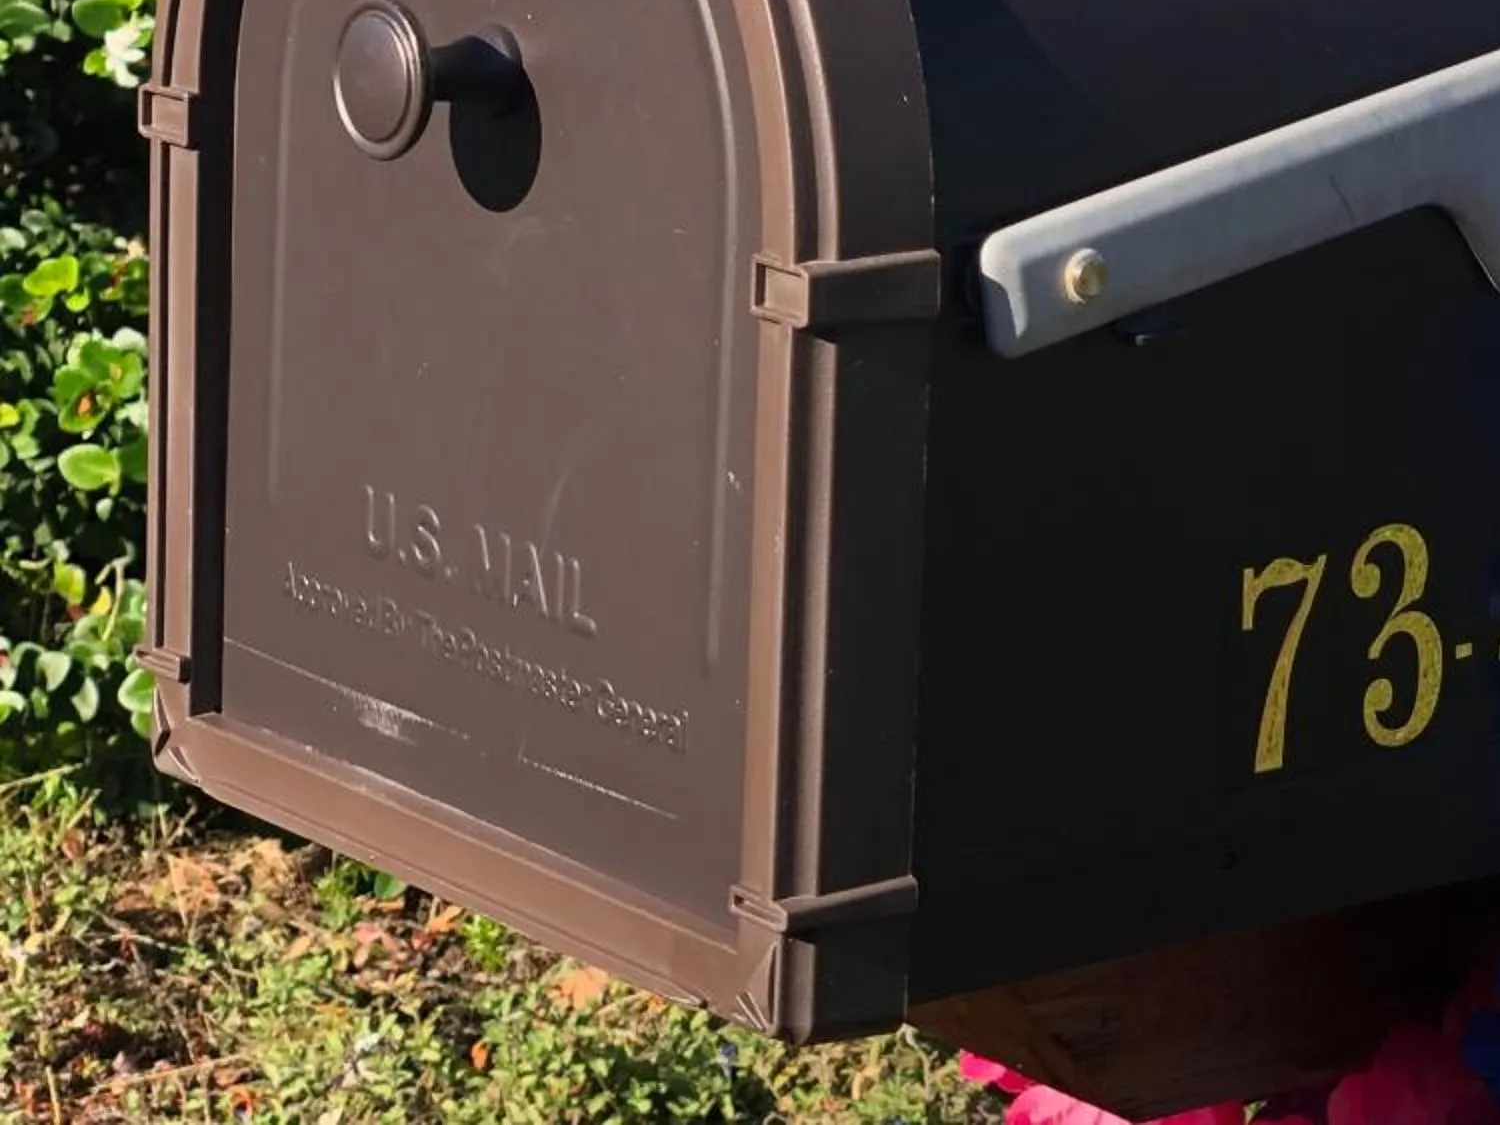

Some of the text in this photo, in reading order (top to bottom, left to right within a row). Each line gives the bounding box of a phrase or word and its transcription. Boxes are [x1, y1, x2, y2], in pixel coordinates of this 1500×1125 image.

[363, 482, 597, 638] U.S. MAIL
[596, 678, 690, 756] General
